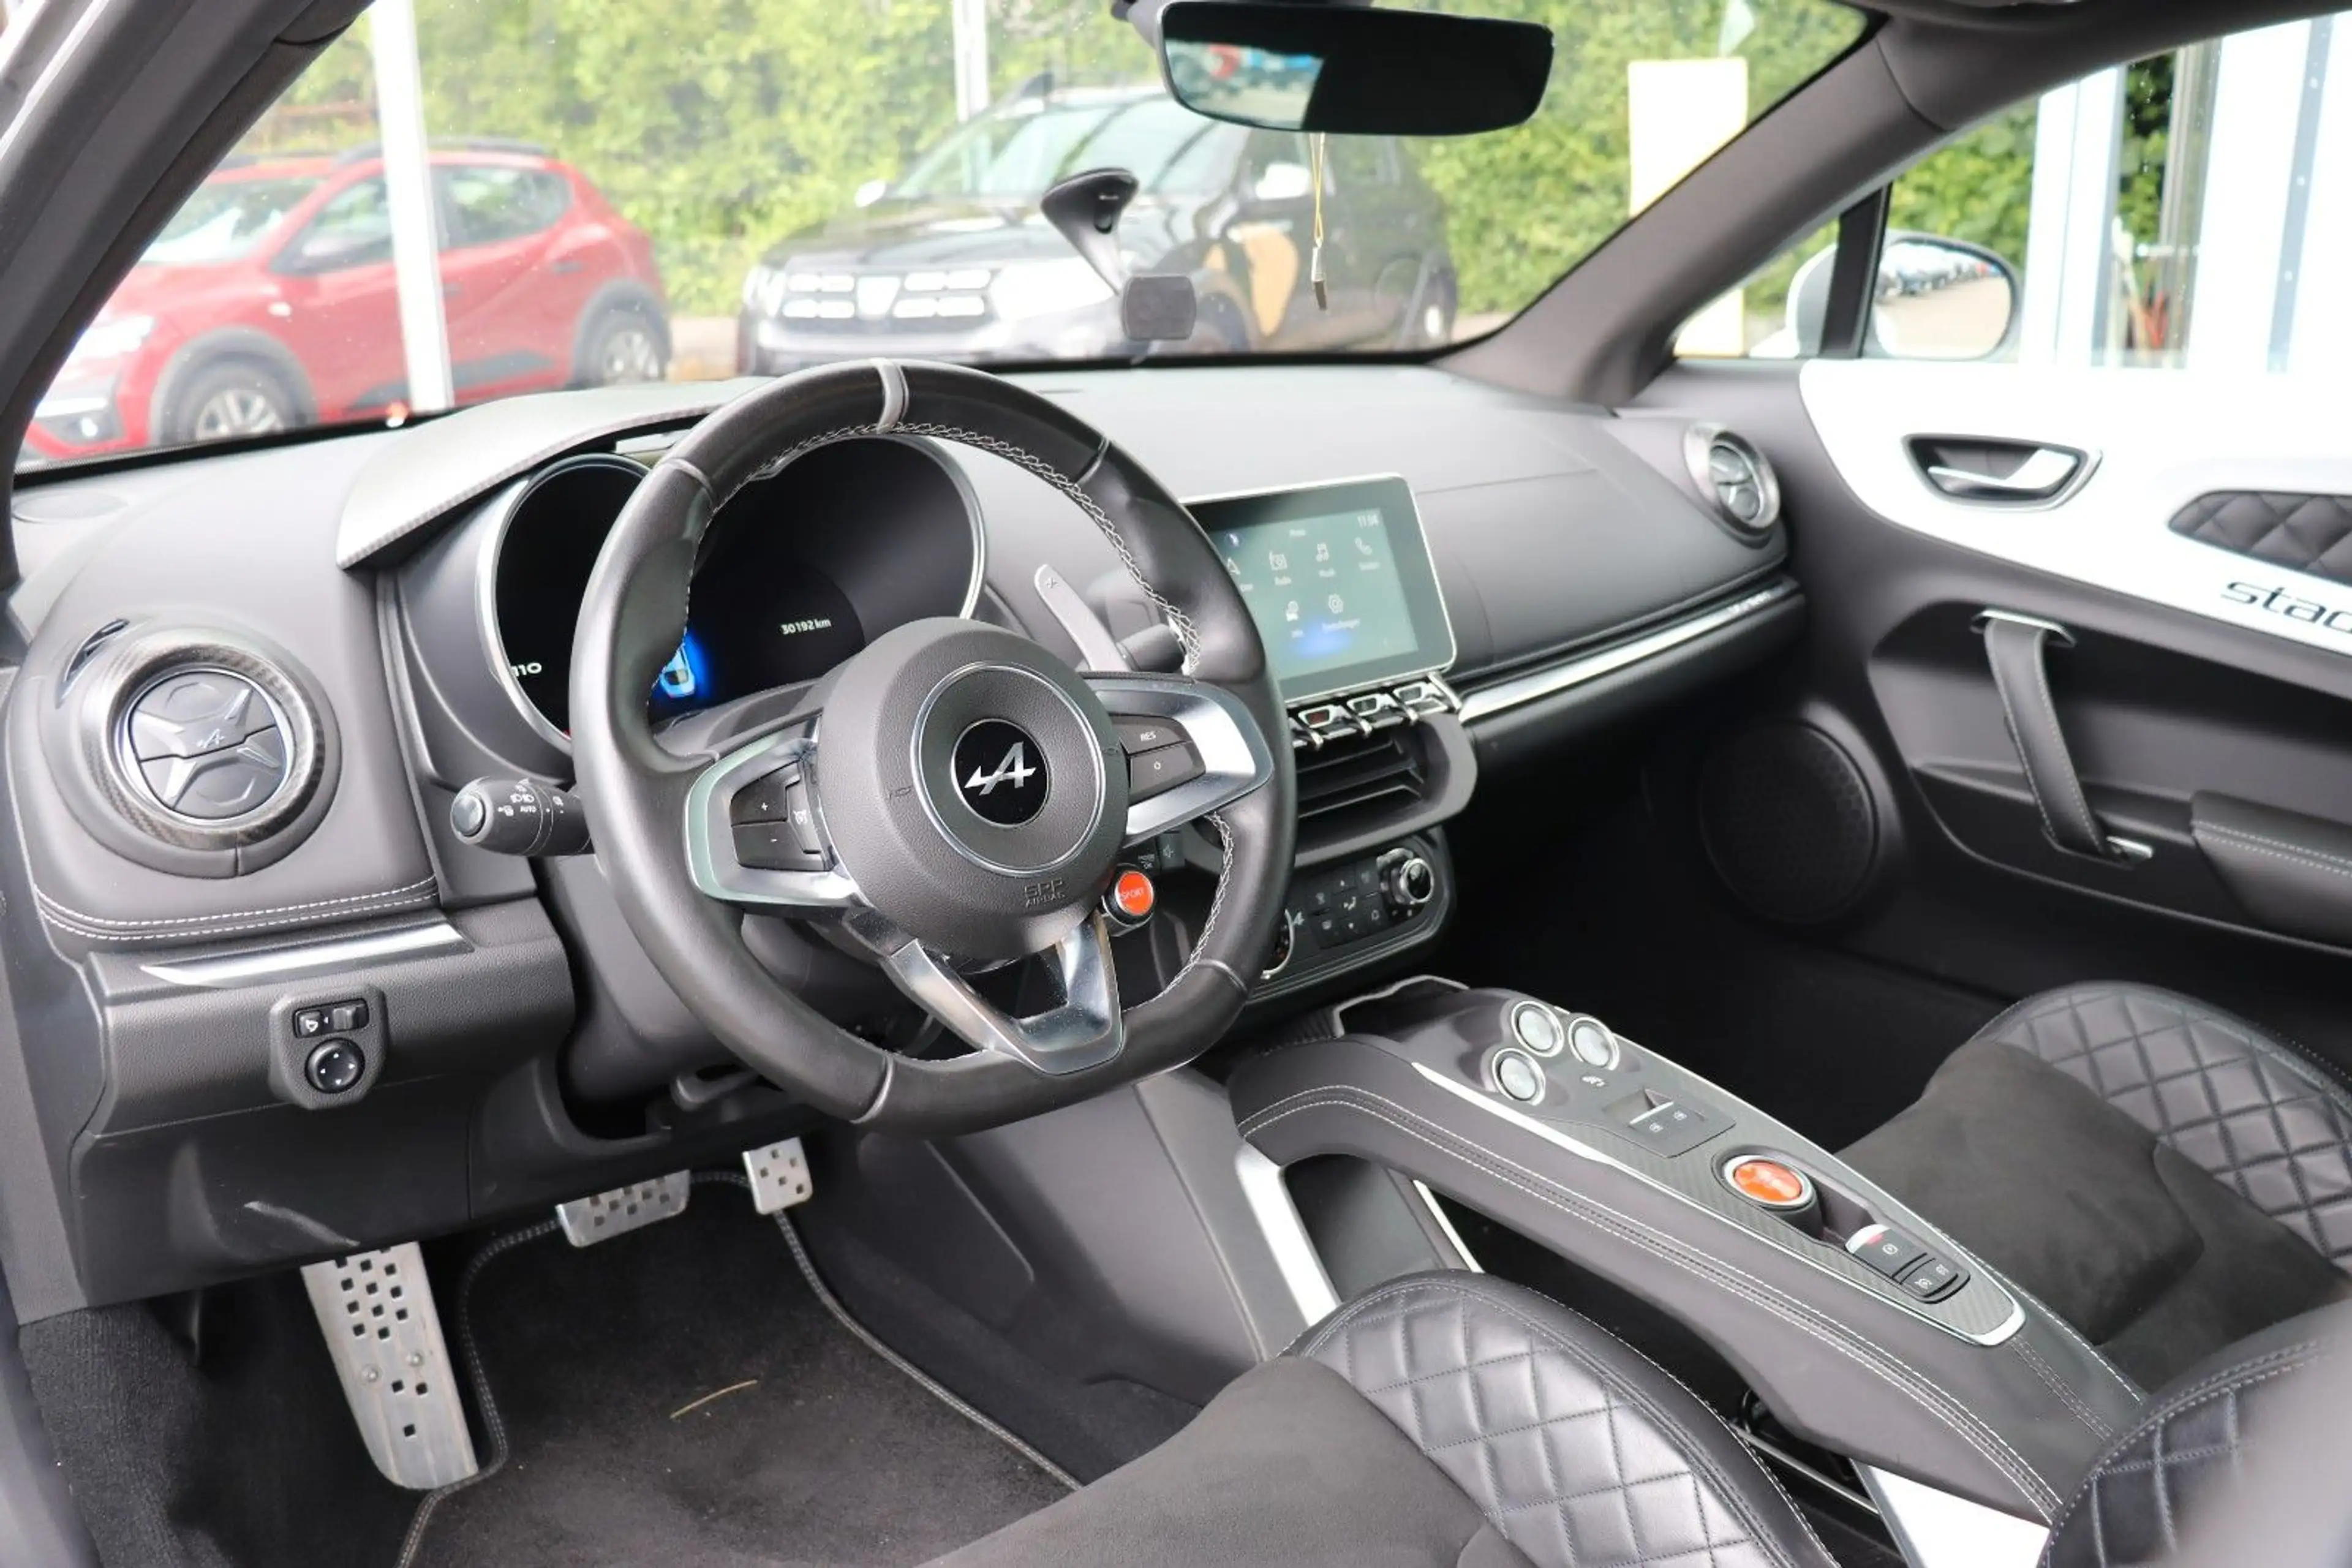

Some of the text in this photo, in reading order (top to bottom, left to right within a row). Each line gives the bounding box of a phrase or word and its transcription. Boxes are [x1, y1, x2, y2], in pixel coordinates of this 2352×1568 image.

[780, 618, 832, 635] 30192 km
[511, 662, 542, 677] 110
